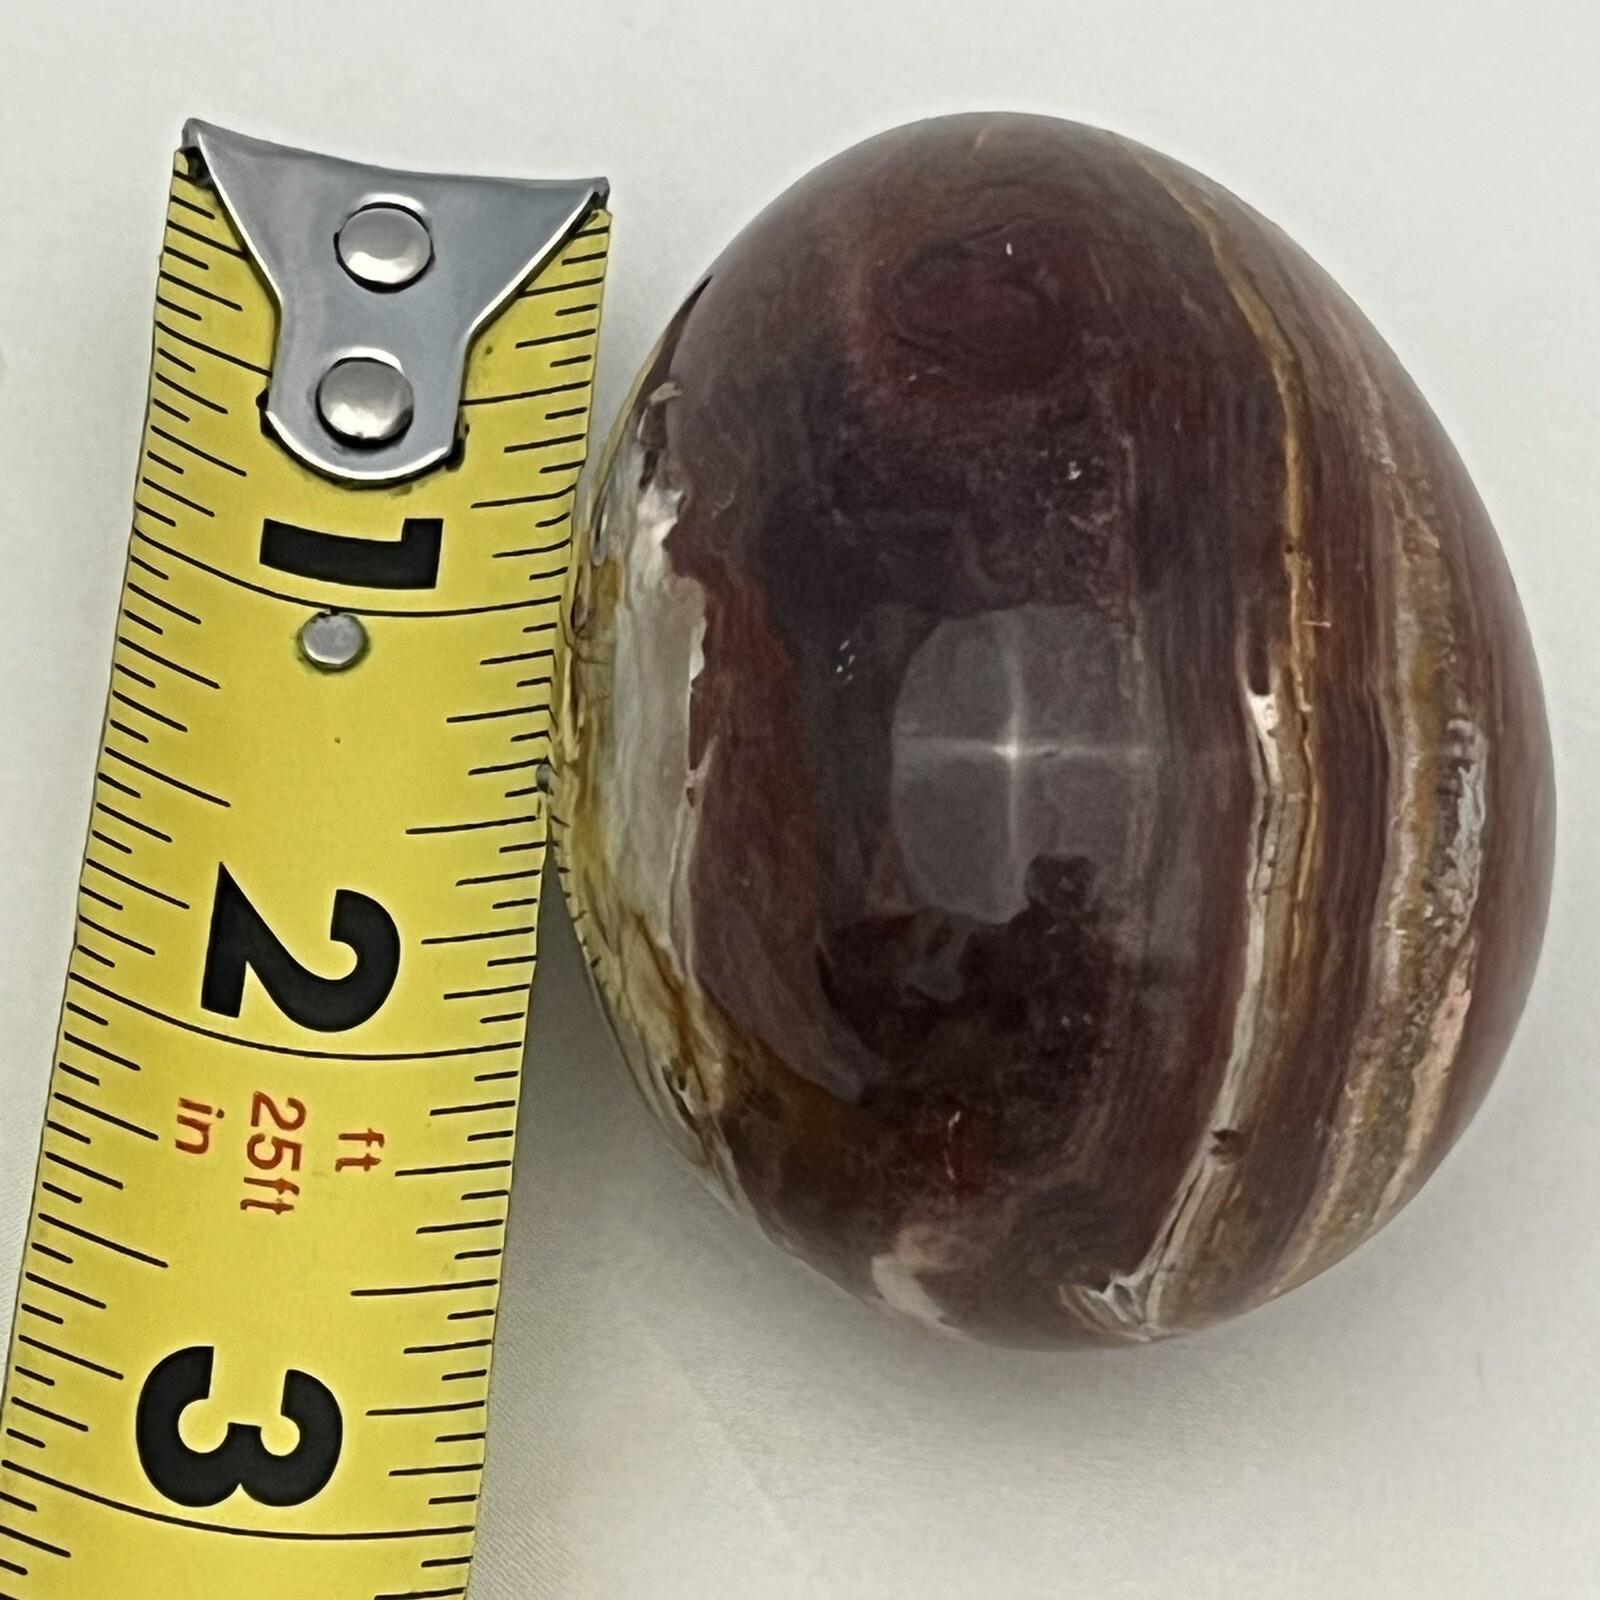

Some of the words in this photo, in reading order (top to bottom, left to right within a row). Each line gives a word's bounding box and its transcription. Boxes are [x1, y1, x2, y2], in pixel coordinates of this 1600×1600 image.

[260, 518, 444, 589] 1
[201, 861, 401, 1032] 2
[175, 1097, 225, 1154] in
[239, 1090, 307, 1215] 25ft
[335, 1127, 385, 1172] ft
[136, 1346, 343, 1508] 3
